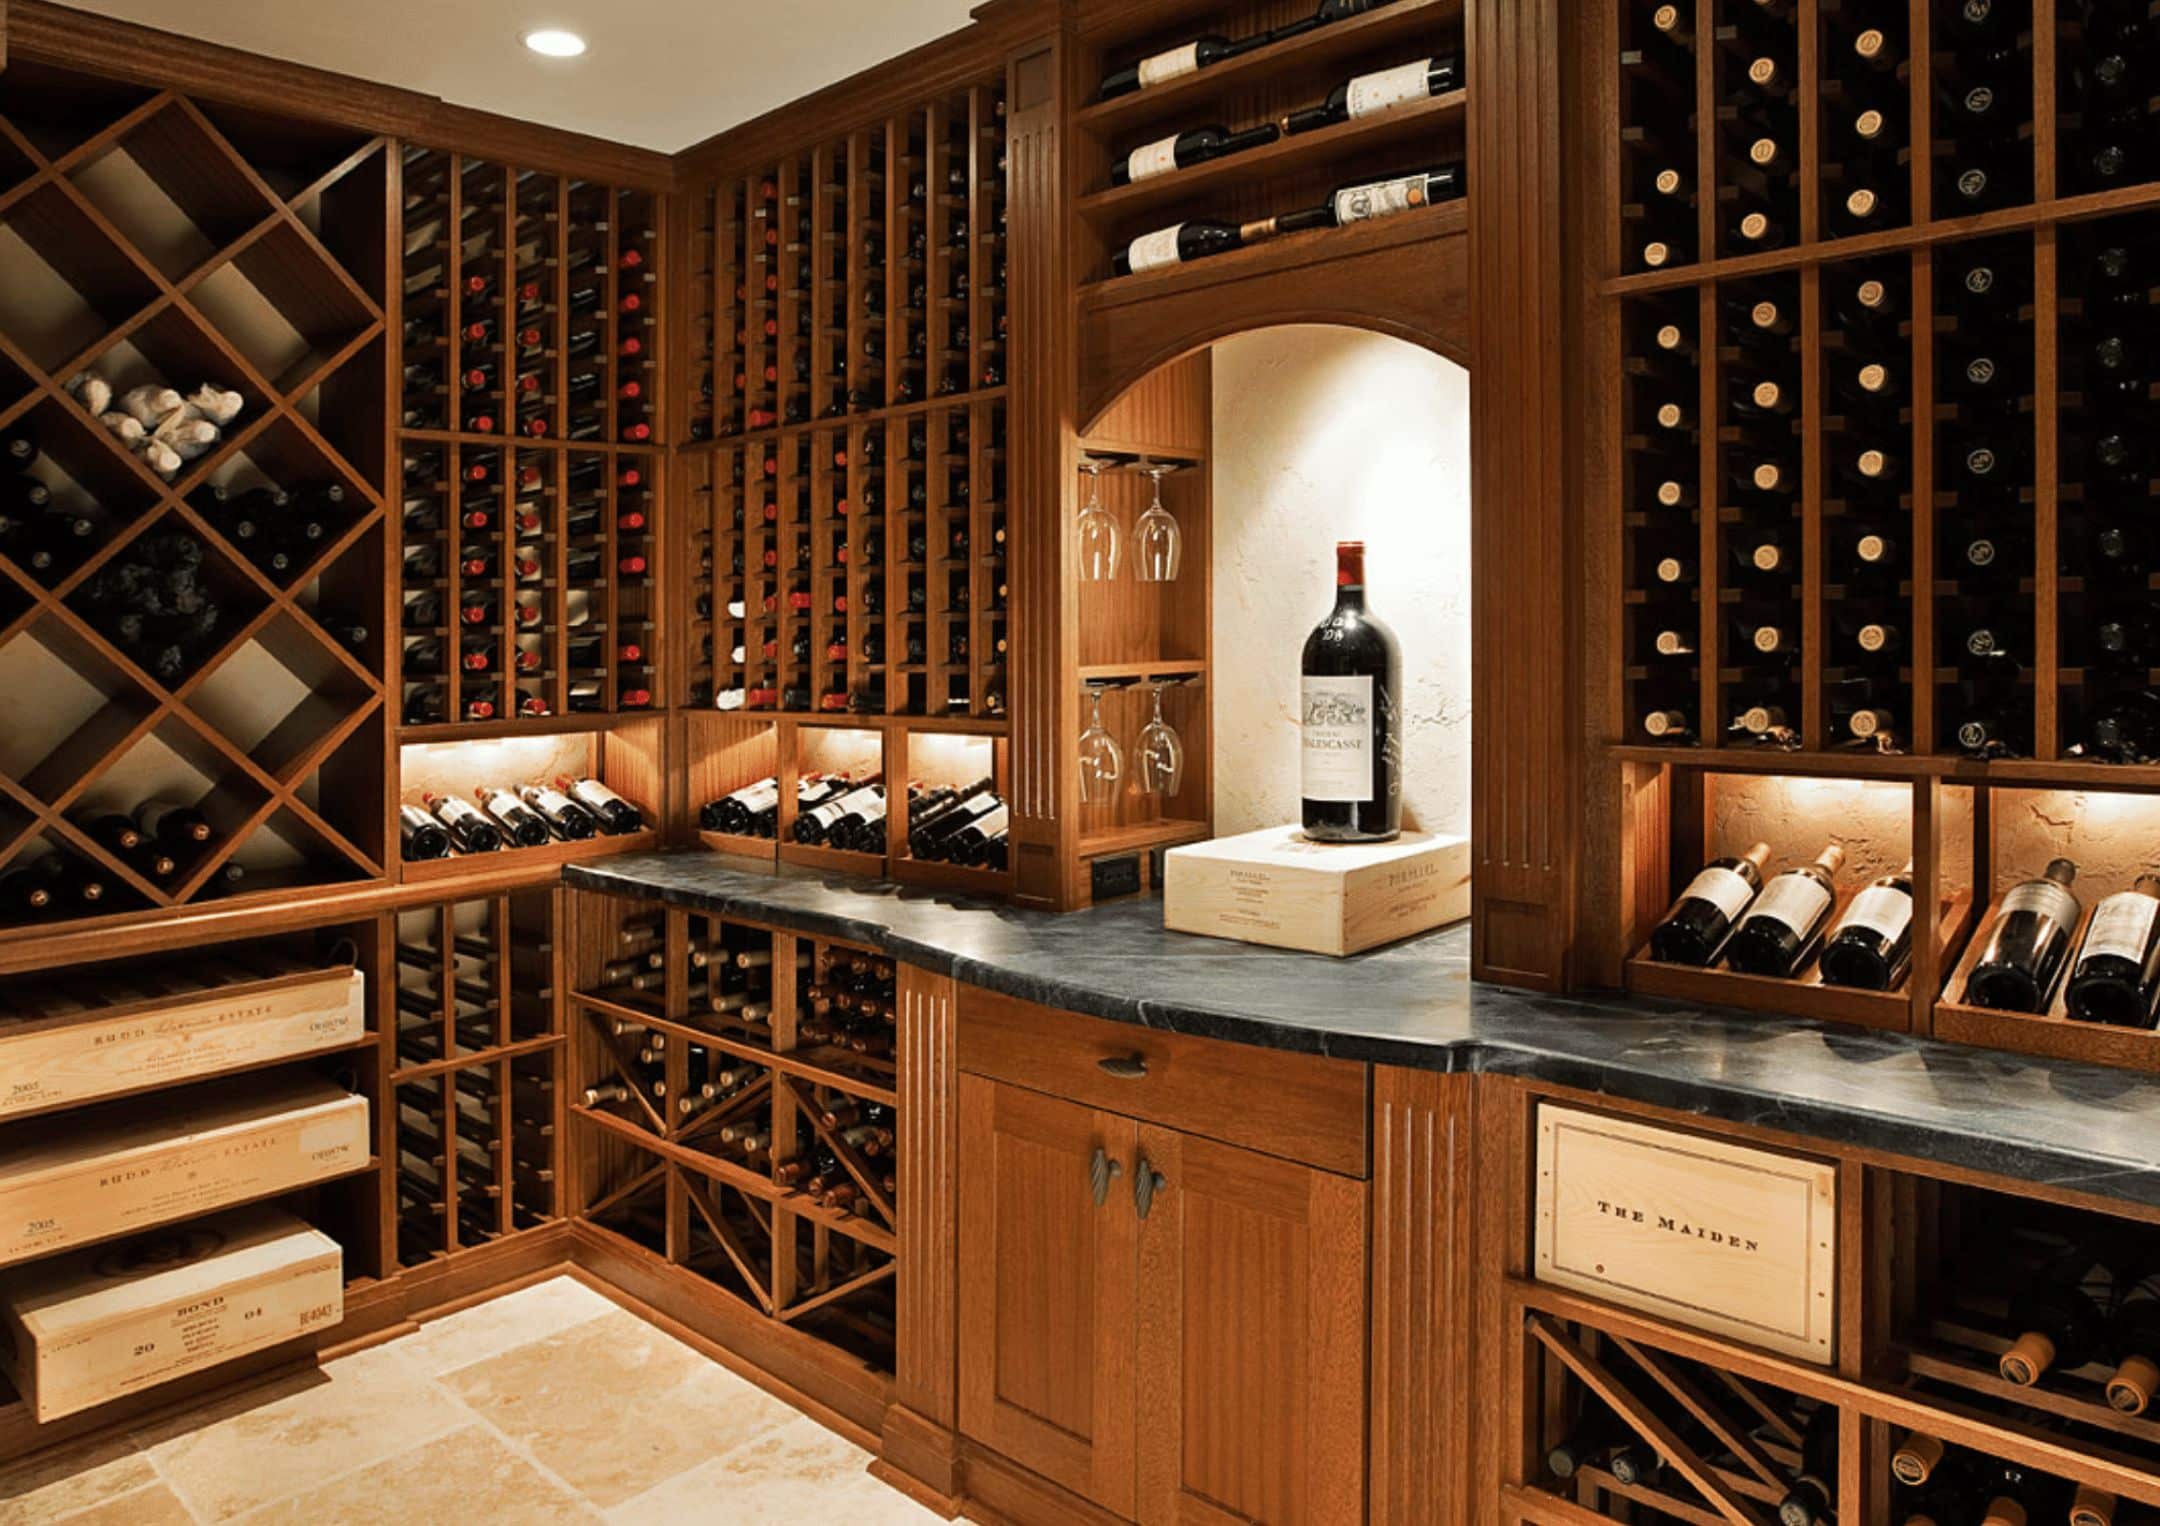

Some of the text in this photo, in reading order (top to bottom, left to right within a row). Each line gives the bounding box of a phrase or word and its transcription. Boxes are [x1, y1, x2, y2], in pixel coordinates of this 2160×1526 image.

[1597, 1200, 1759, 1251] THE MAIDEN
[177, 1296, 225, 1317] BOND
[133, 1343, 155, 1357] 20
